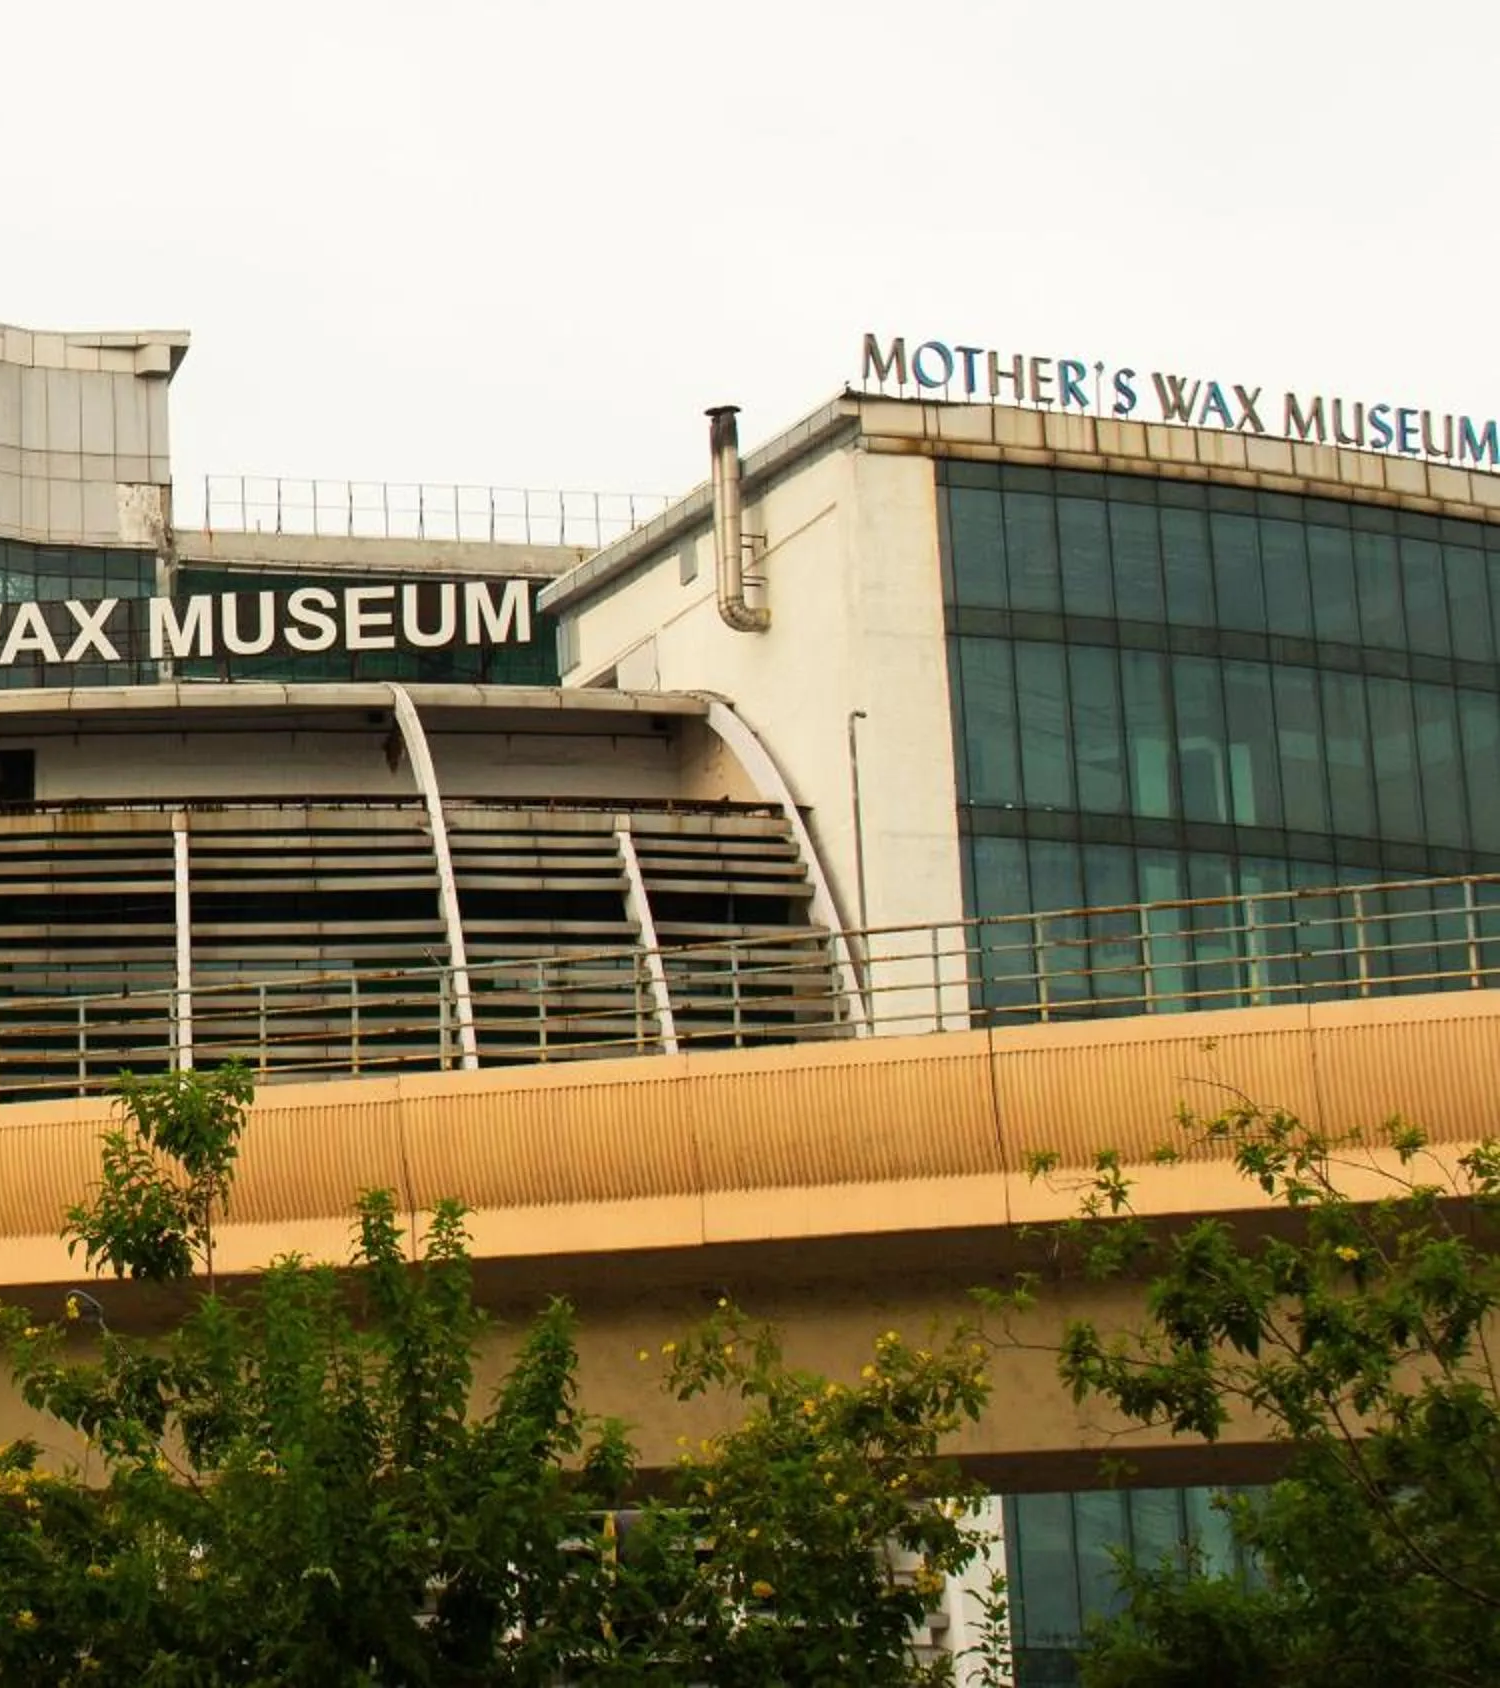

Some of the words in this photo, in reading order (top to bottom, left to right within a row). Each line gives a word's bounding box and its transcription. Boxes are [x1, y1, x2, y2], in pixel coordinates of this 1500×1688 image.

[862, 333, 1137, 415] MOTHER'S
[1153, 373, 1264, 432] WAX
[1284, 393, 1500, 464] MUSEUM
[149, 579, 532, 658] MUSEUM
